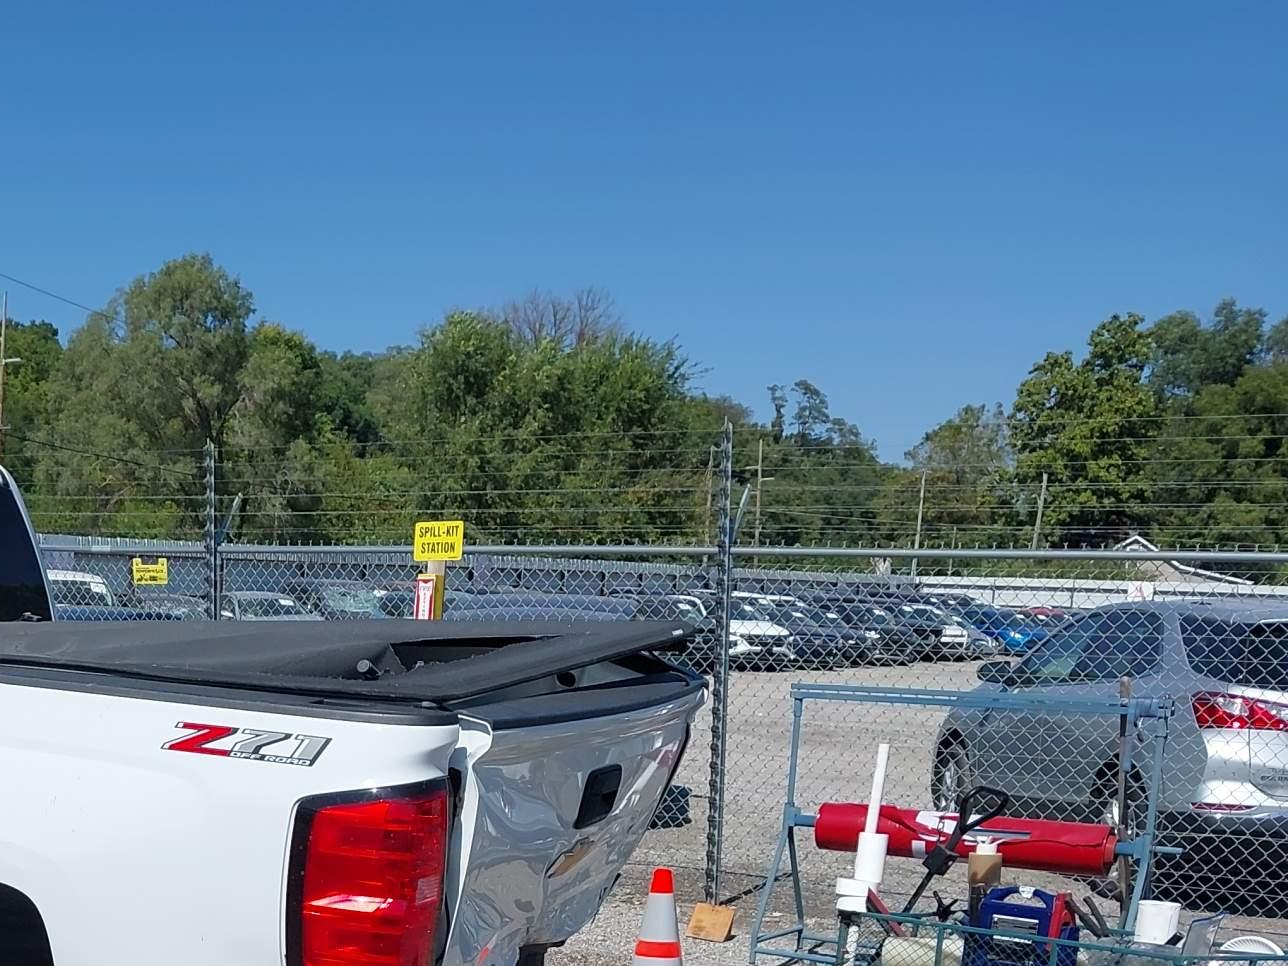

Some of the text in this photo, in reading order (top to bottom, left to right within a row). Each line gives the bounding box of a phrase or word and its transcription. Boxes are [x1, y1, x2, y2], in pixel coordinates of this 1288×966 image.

[419, 525, 460, 538] SPILL-KIT
[420, 541, 456, 554] STATION
[160, 721, 333, 767] Z71
[229, 751, 312, 767] OFF ROAD
